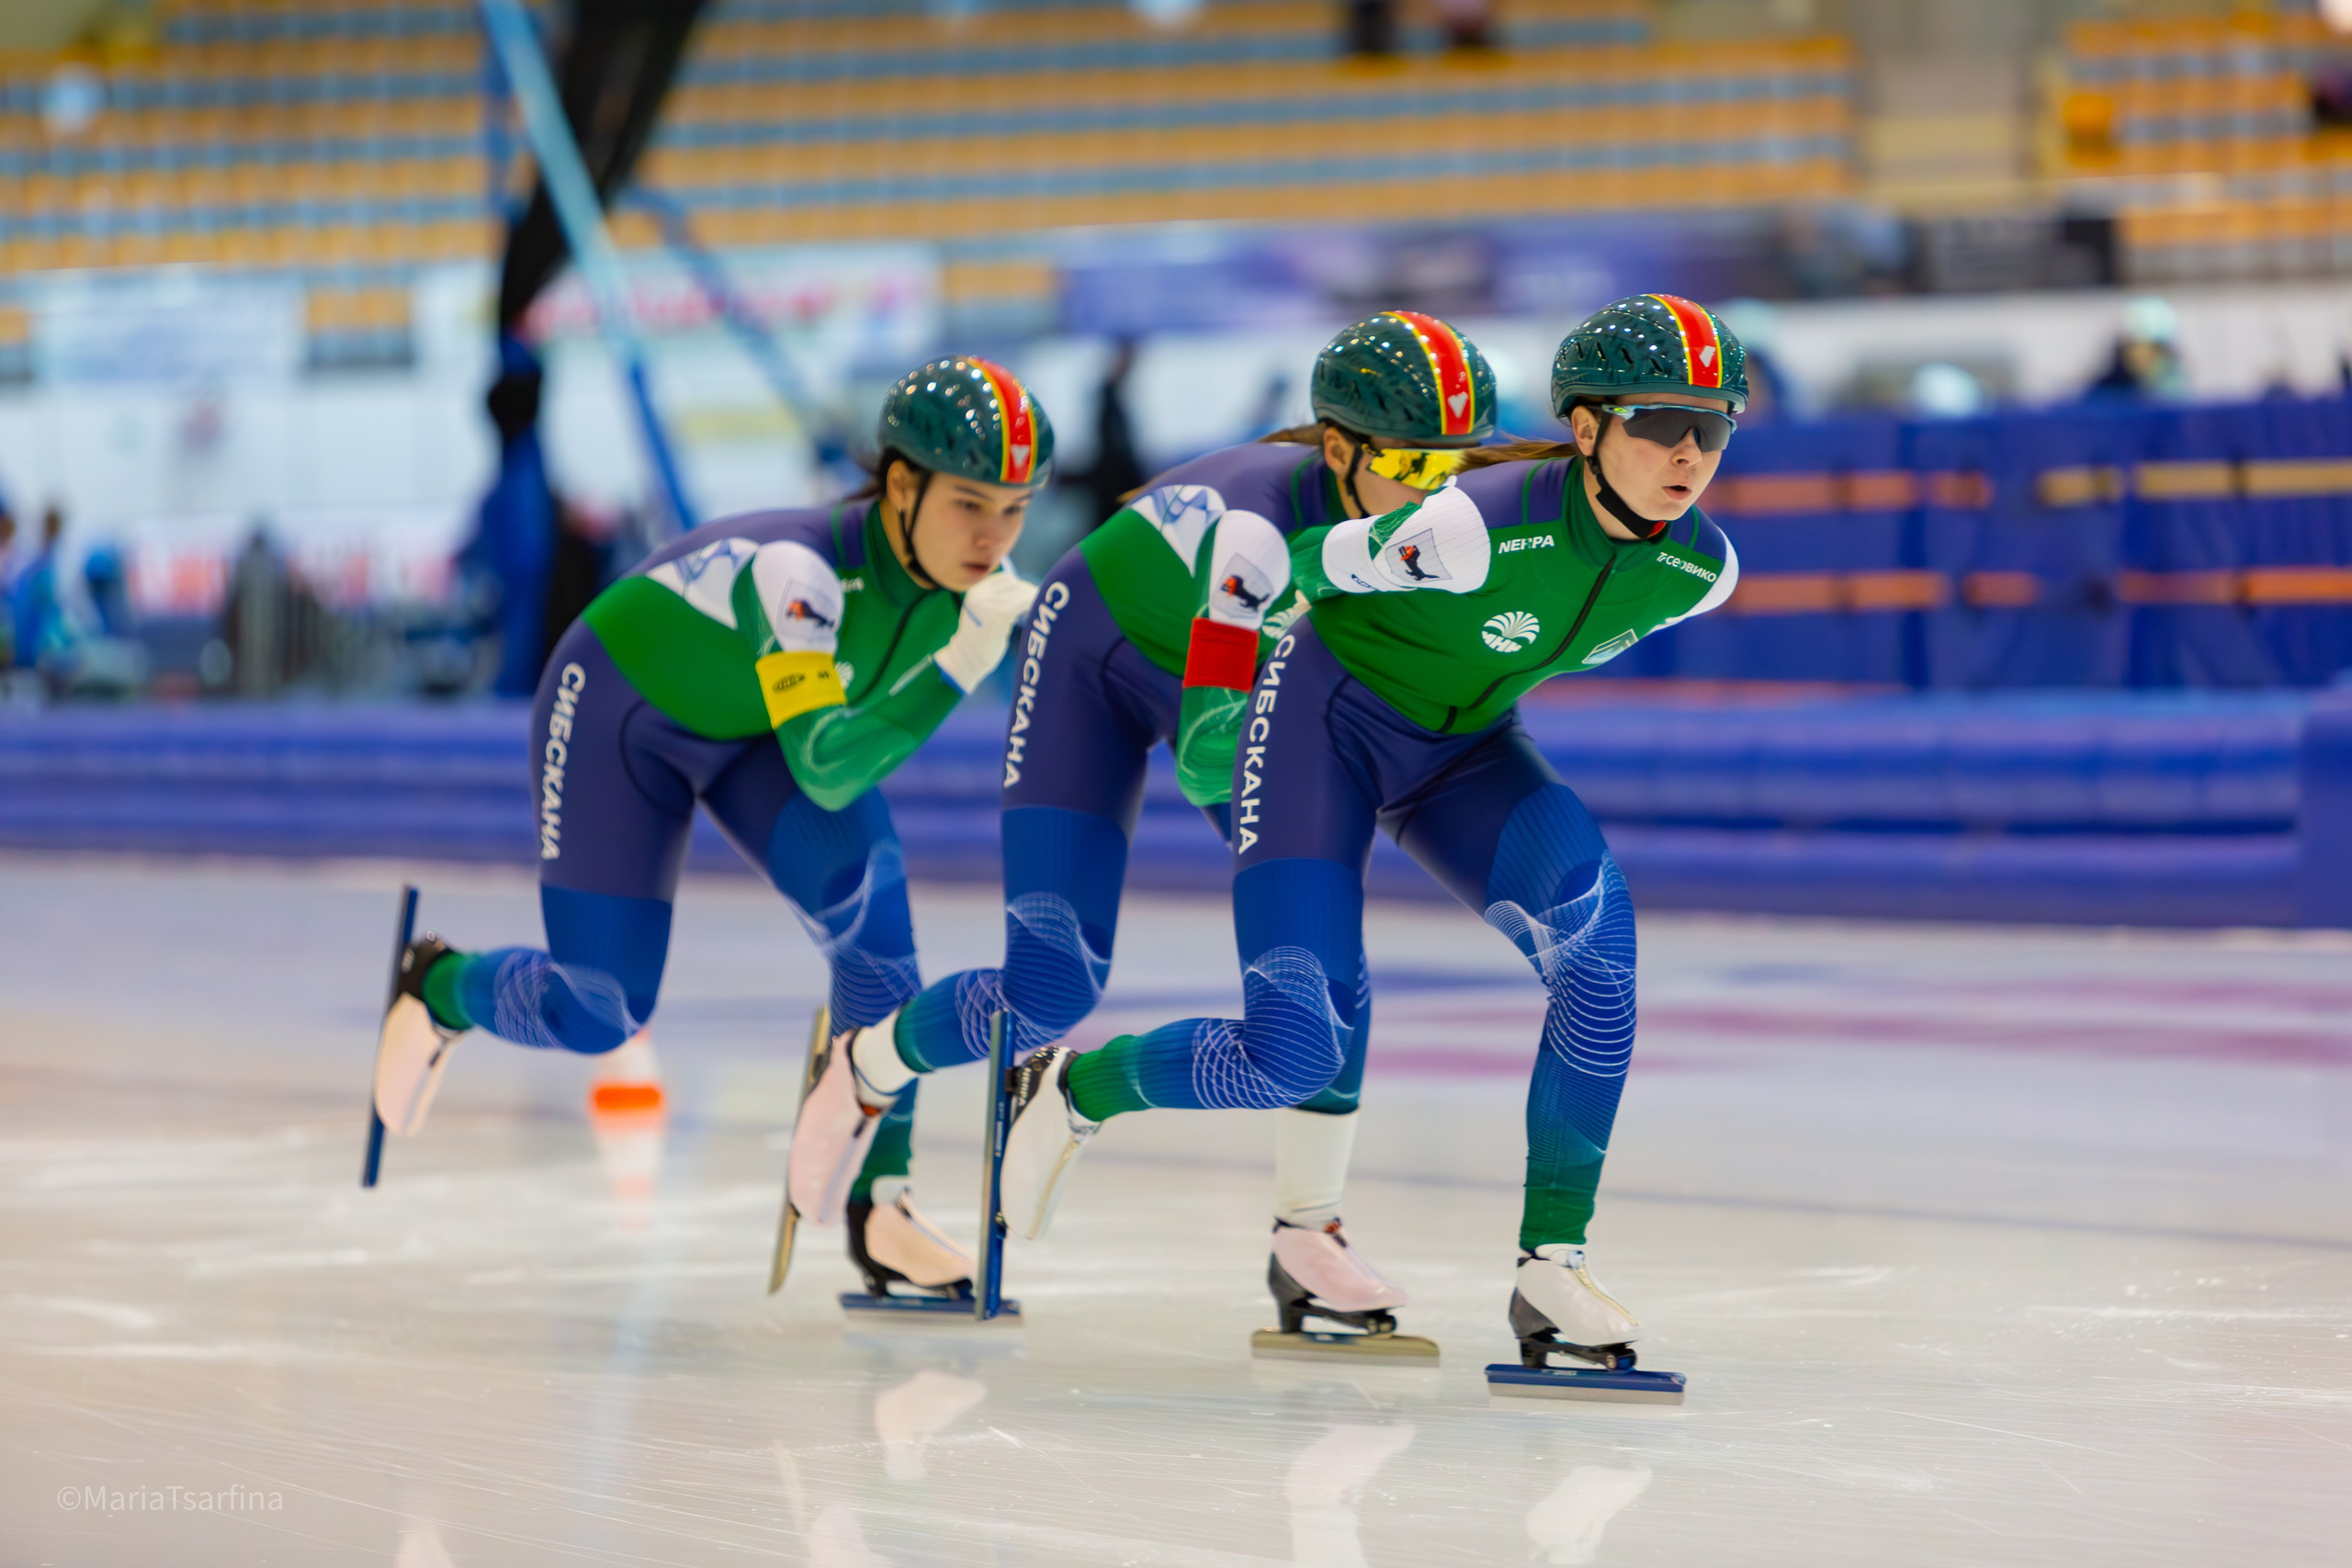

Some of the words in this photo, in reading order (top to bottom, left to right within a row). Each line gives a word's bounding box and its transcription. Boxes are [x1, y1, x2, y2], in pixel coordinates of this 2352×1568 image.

[540, 661, 586, 860] СИБСКАНА
[1003, 581, 1070, 789] СИБСКАНА
[1238, 634, 1295, 854] СИБСКАНА
